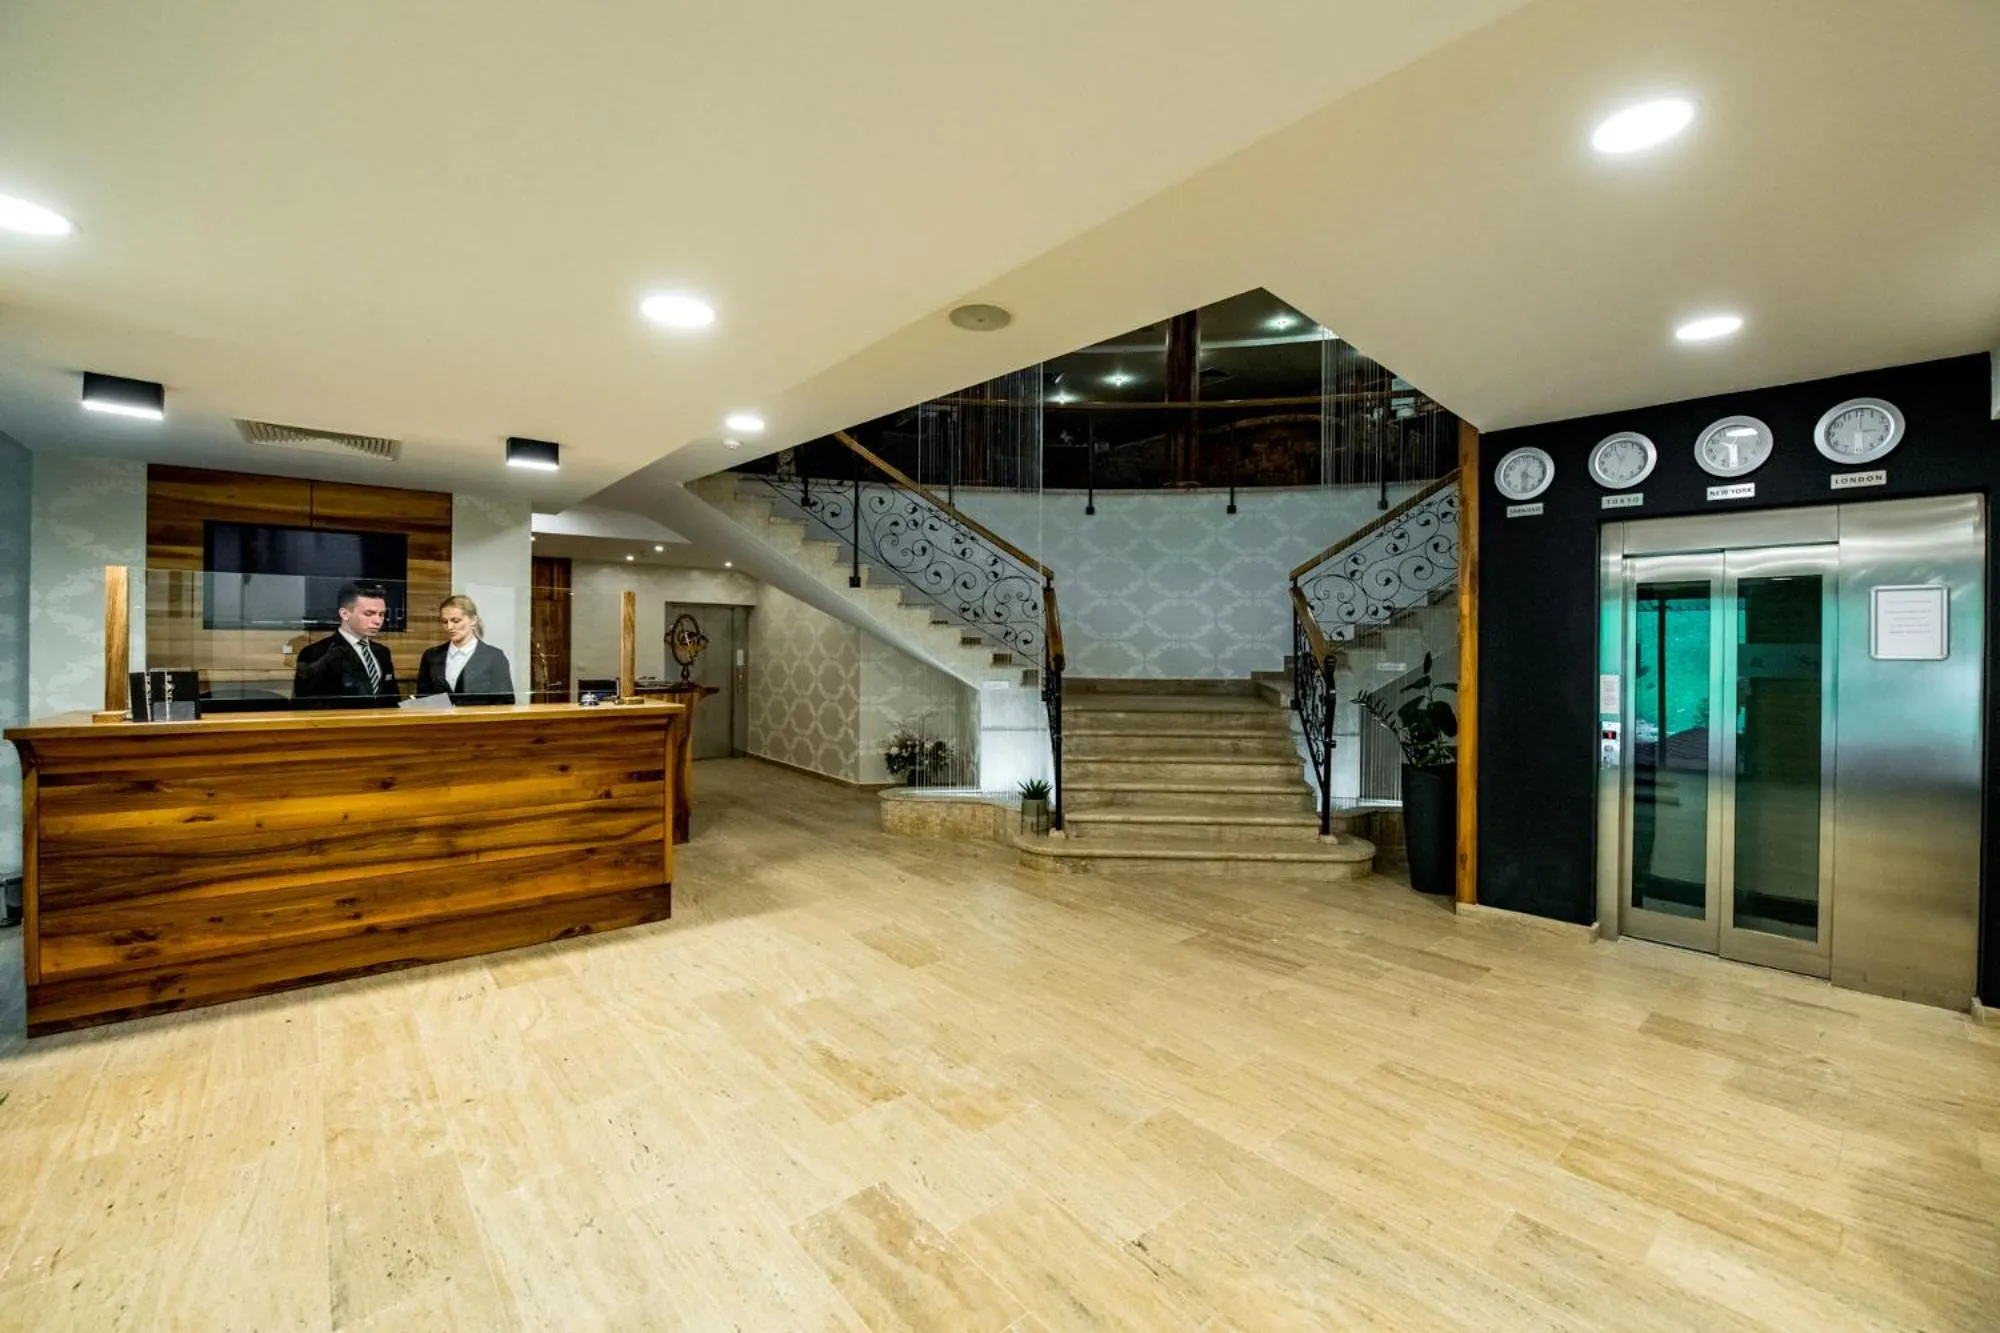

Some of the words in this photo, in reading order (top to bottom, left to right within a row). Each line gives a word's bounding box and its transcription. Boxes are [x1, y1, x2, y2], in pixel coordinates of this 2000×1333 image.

[1835, 475, 1883, 485] LONDON
[1731, 487, 1752, 495] YORK
[1606, 496, 1640, 505] TOKYO
